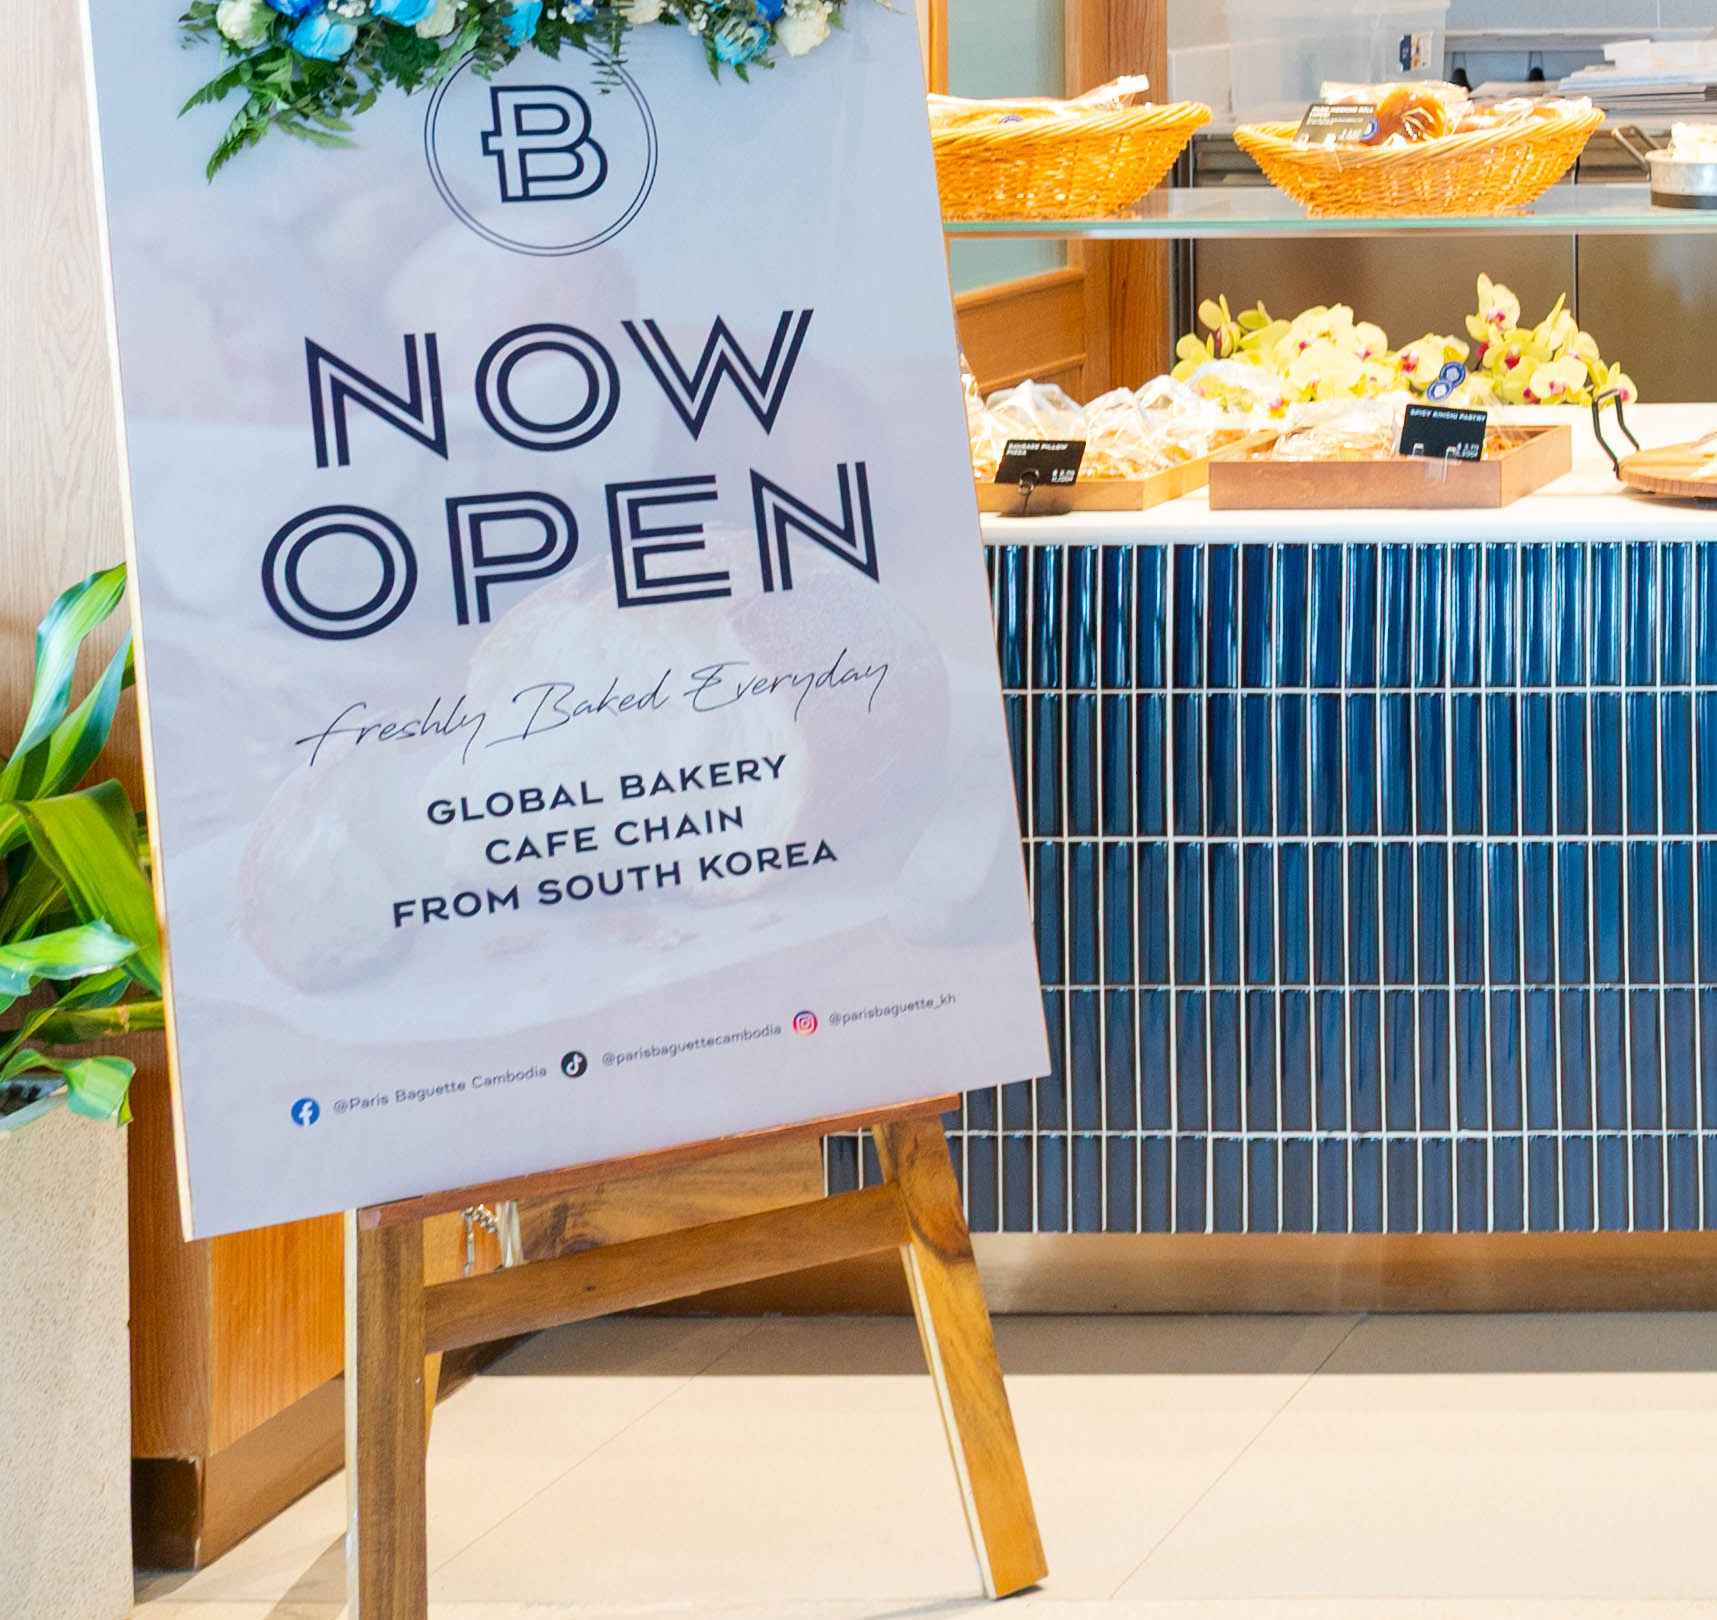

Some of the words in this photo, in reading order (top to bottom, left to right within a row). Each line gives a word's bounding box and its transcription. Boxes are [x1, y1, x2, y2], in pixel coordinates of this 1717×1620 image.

[305, 309, 813, 468] NOW
[1459, 413, 1486, 422] PASTRY
[262, 462, 880, 640] OPEN
[484, 669, 671, 749] Baked
[683, 648, 889, 723] Everyday
[427, 781, 604, 825] GLOBAL
[620, 754, 788, 800] BAKERY
[485, 826, 598, 865] CAFE
[614, 806, 743, 846] CHAIN
[393, 885, 520, 928] FROM
[537, 861, 681, 905] SOUTH
[699, 839, 838, 881] KOREA
[601, 1023, 782, 1066] @parisbaguettecambodia
[333, 1095, 389, 1115] @Paris
[395, 1080, 466, 1104] Baguette
[471, 1065, 547, 1090] Cambodia
